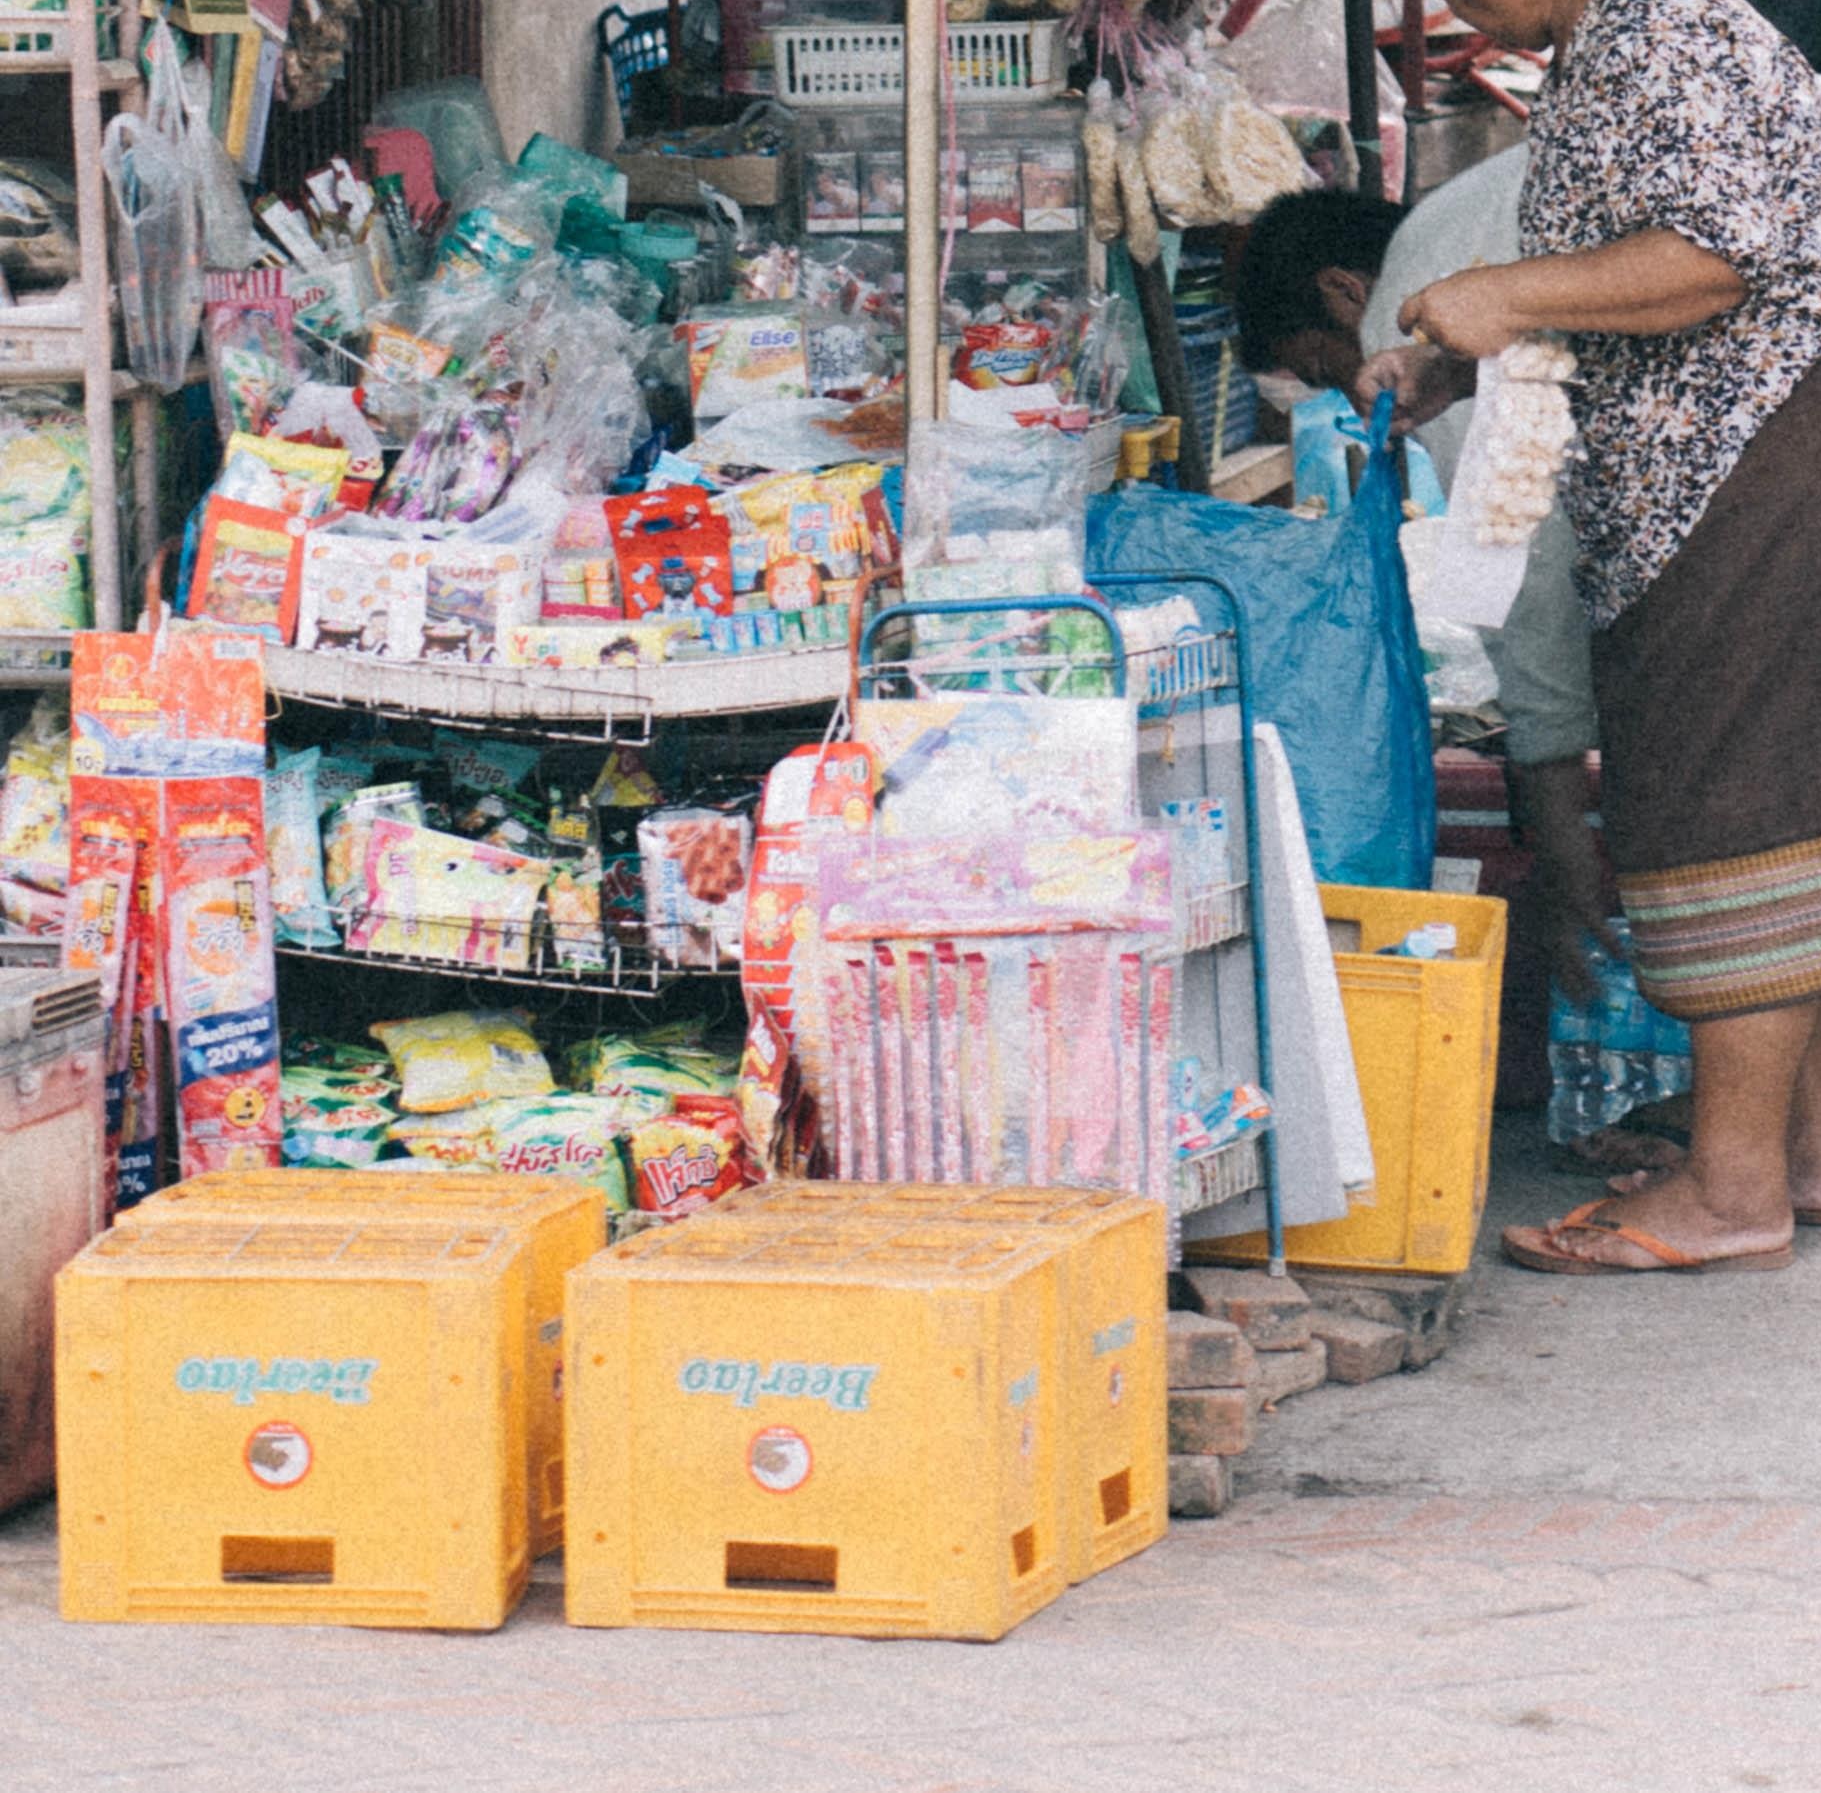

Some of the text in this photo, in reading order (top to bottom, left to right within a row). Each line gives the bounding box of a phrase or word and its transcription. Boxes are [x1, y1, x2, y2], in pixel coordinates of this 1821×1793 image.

[513, 634, 558, 658] Ypi
[205, 1037, 265, 1069] 20%
[678, 1358, 879, 1412] Beerlao
